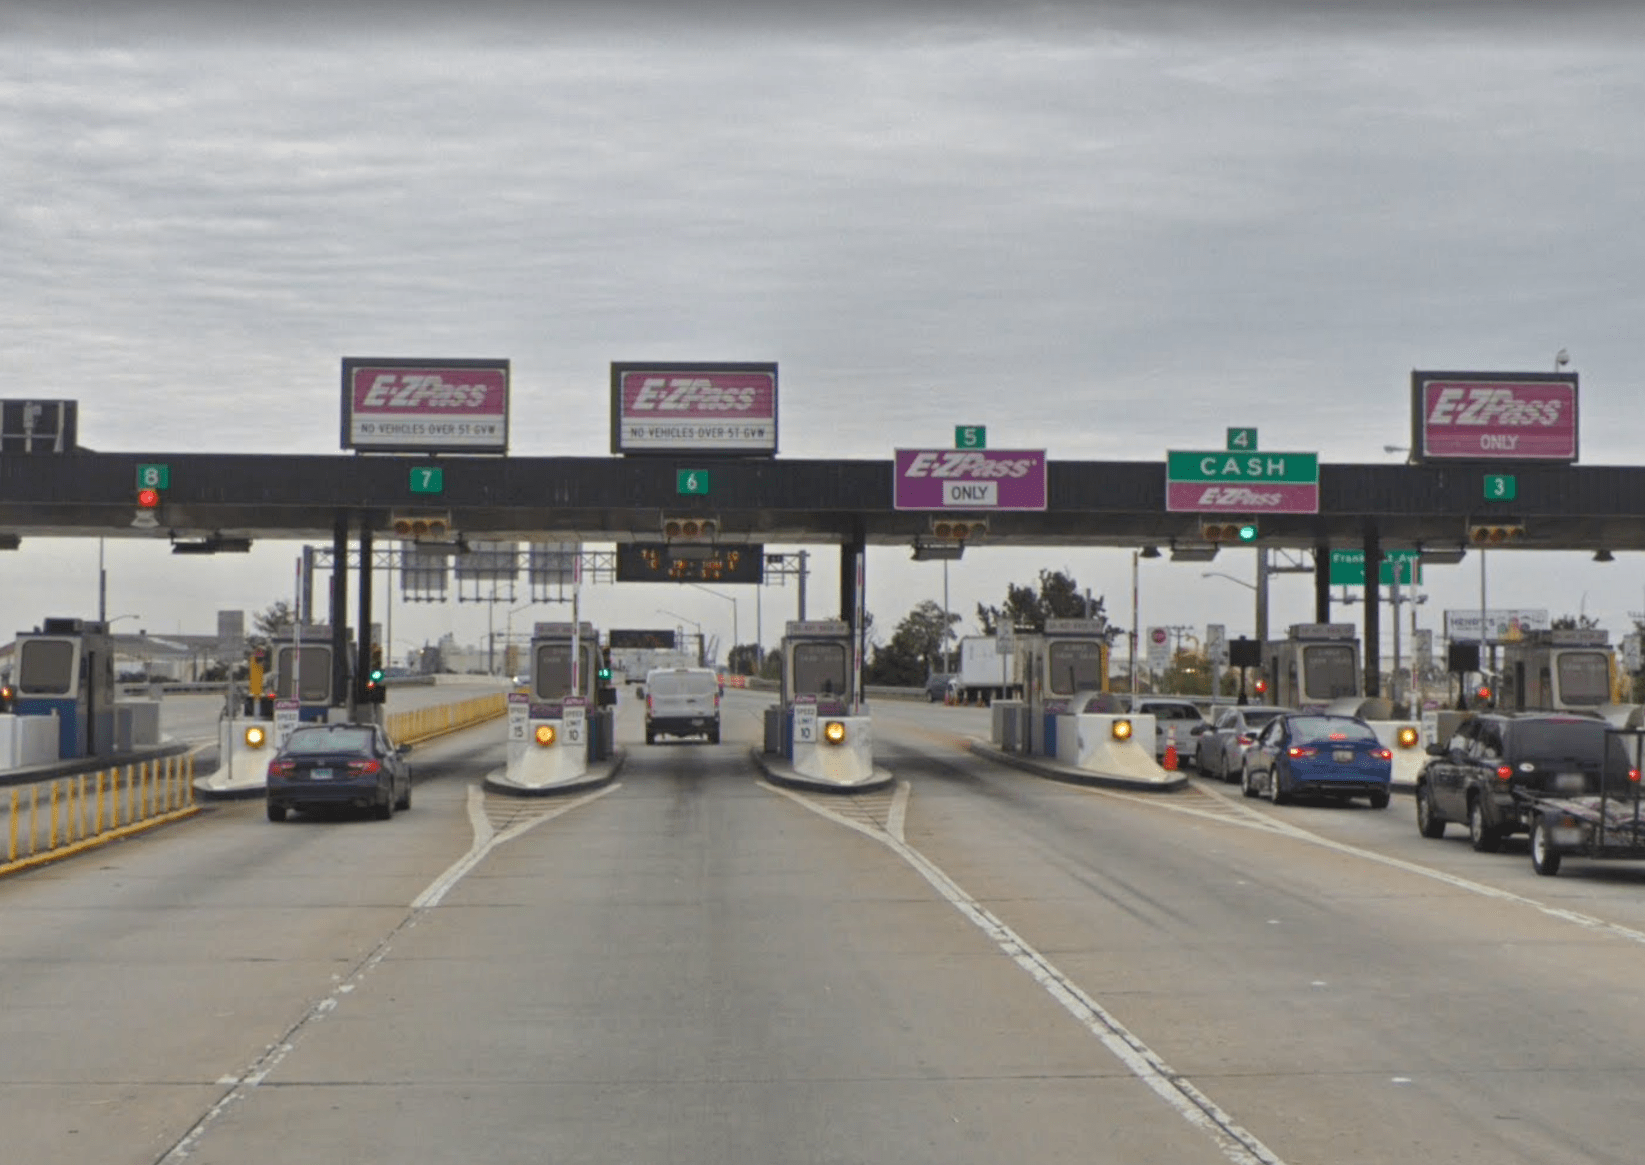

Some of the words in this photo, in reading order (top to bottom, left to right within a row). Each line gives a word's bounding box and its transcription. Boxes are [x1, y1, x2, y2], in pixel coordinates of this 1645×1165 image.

[363, 374, 488, 407] E-ZPass
[631, 378, 757, 410] E-ZPass
[1428, 388, 1562, 426] E-ZPass
[361, 423, 375, 434] NO
[379, 423, 425, 435] VEHICLES
[429, 424, 454, 435] OVER
[474, 424, 496, 435] GVW
[631, 427, 644, 438] NO
[649, 427, 694, 438] VEHICLES
[700, 427, 724, 438] OVER
[744, 427, 765, 438] GVW
[963, 428, 977, 446] 5
[1233, 430, 1249, 447] 4
[1480, 434, 1520, 450] ONLY
[904, 452, 1038, 478] E-ZPass
[1200, 457, 1285, 476] CASH
[144, 467, 159, 486] 8
[421, 470, 432, 488] 7
[686, 473, 698, 490] 6
[951, 486, 988, 500] ONLY
[1494, 478, 1504, 496] 3
[1198, 487, 1283, 506] E-ZPass
[514, 726, 523, 737] 15
[569, 730, 579, 740] 10
[801, 728, 810, 739] 10
